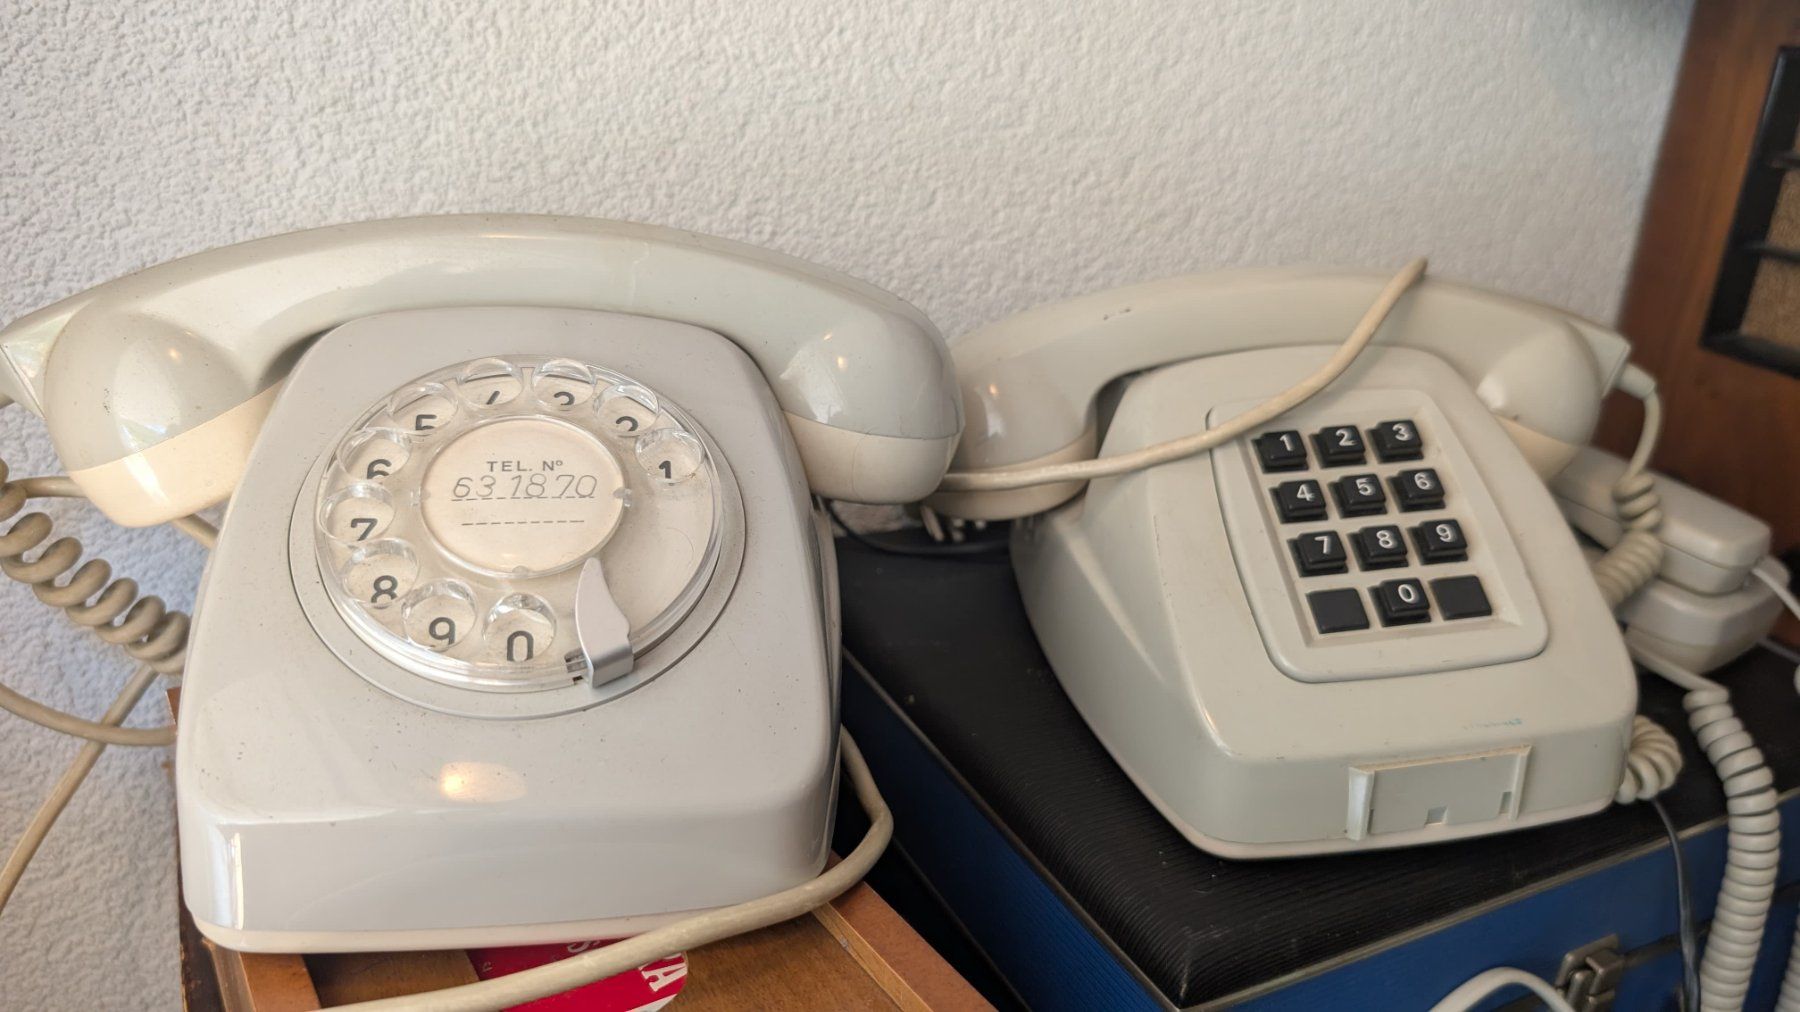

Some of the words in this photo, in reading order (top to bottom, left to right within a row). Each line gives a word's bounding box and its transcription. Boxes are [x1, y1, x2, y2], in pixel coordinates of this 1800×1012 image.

[1279, 434, 1294, 452] 1
[1335, 428, 1356, 447] 2
[1391, 423, 1411, 442] 3
[486, 460, 533, 473] TEL.
[658, 460, 672, 480] 1
[1296, 483, 1315, 502] 4
[1355, 477, 1375, 497] 5
[1414, 472, 1432, 491] 6
[351, 517, 378, 542] 7
[1314, 535, 1330, 555] 7
[1376, 529, 1394, 549] 8
[1435, 523, 1452, 543] 9
[370, 575, 398, 604] 8
[1398, 583, 1416, 604] 0
[428, 616, 456, 646] 9
[506, 630, 534, 662] 0
